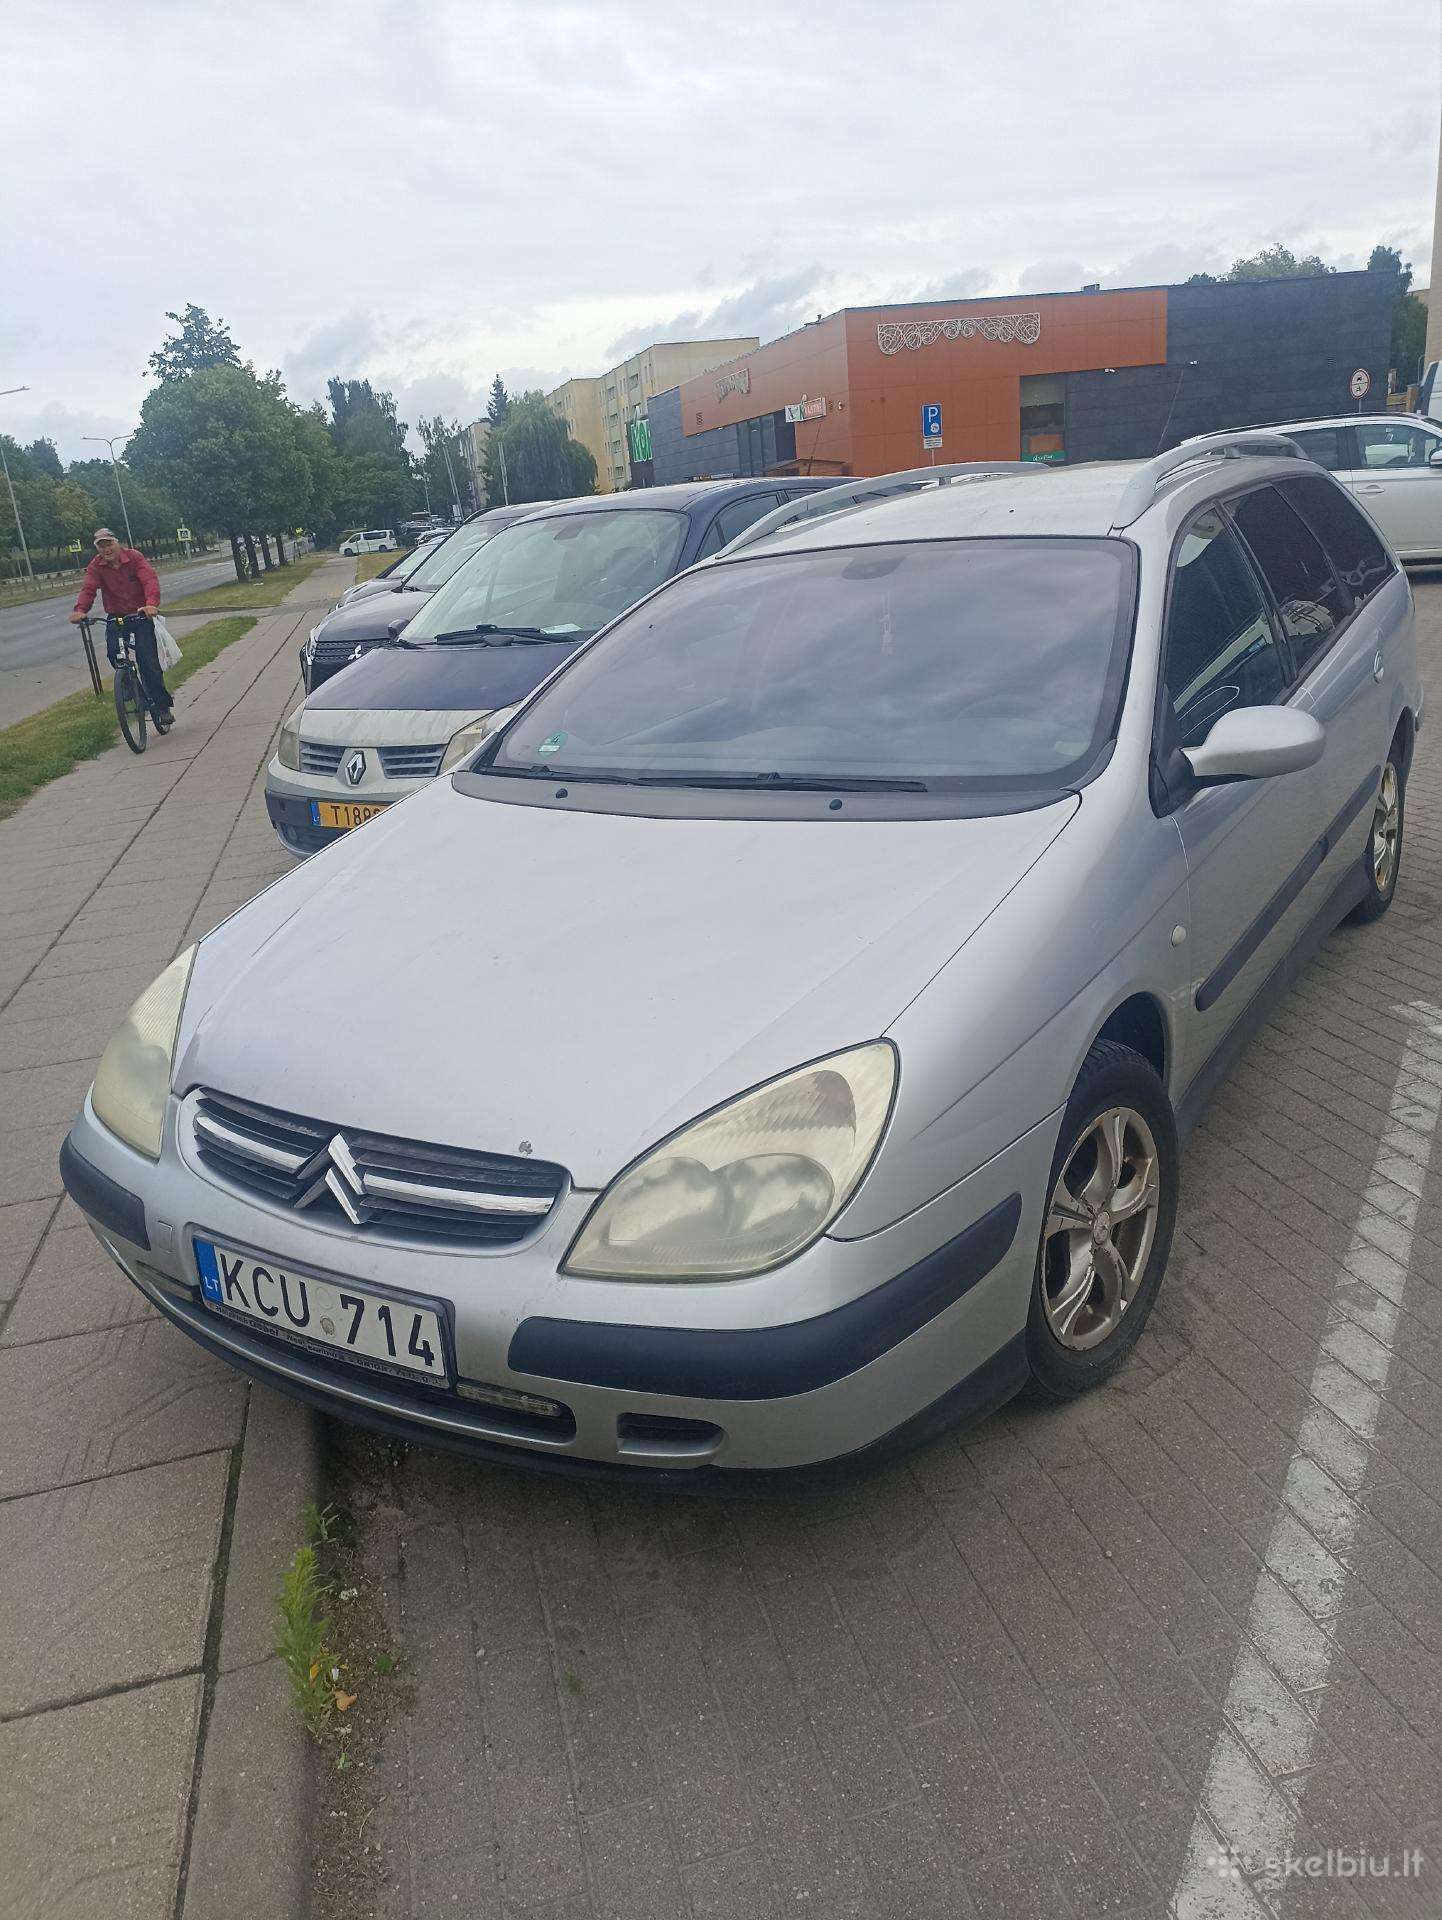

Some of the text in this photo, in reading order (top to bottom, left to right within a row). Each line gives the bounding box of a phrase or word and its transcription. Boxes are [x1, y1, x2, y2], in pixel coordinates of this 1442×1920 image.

[928, 406, 938, 422] P
[204, 1276, 219, 1292] LT
[219, 1252, 310, 1328] KCU
[339, 1292, 435, 1367] 714
